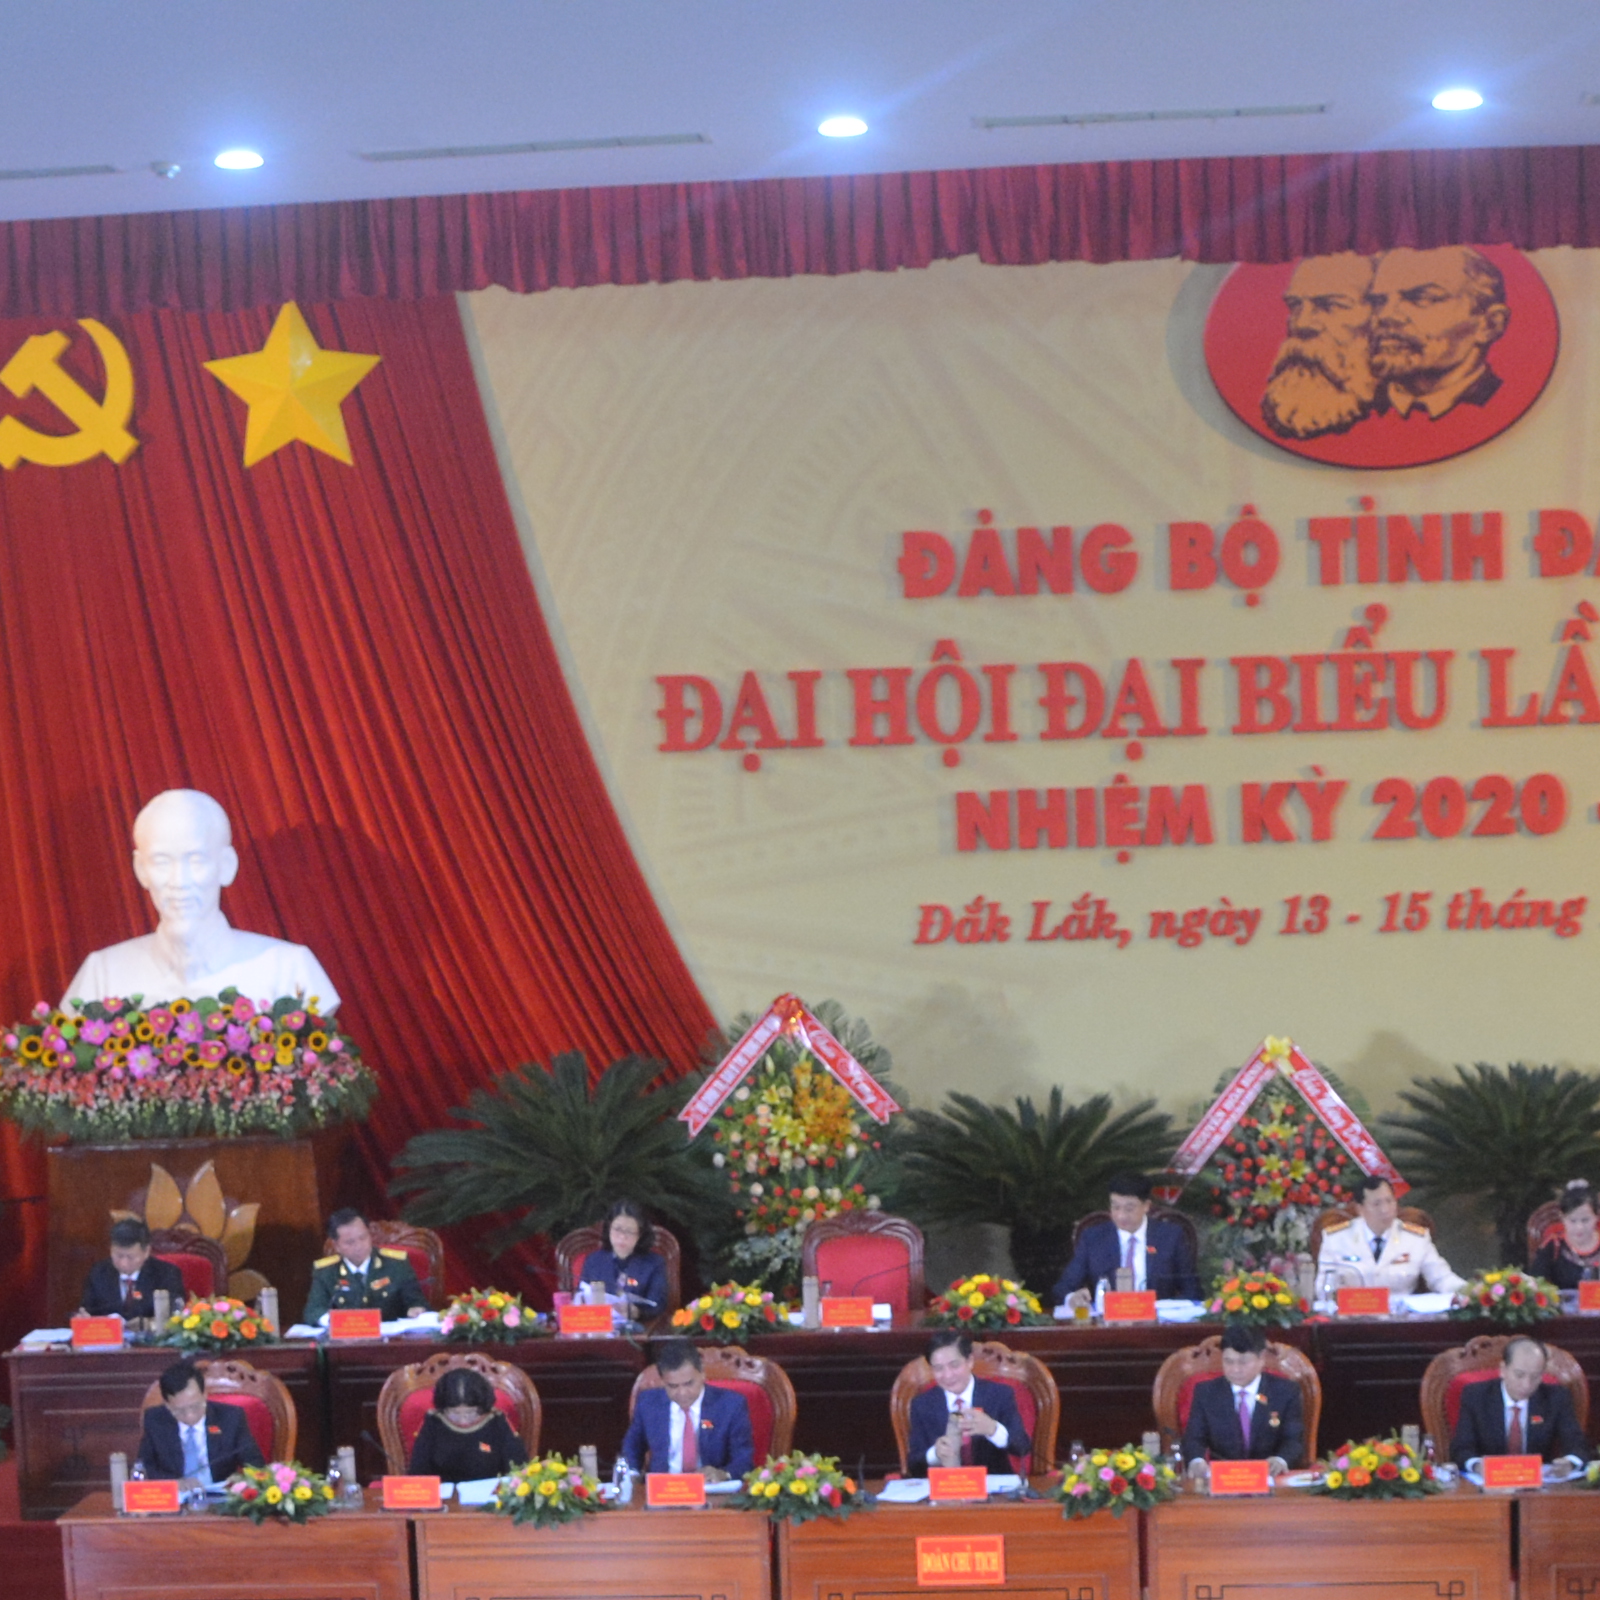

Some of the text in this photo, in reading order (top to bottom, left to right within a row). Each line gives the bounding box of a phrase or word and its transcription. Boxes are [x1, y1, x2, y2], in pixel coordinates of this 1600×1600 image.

[899, 511, 1138, 597] ĐẢNG
[1171, 504, 1280, 606] BỘ
[1310, 496, 1504, 584] TỈNH
[657, 671, 823, 771] ĐẠI
[848, 640, 1017, 767] HỘI
[1040, 659, 1207, 760] ĐẠI
[1232, 604, 1454, 733] BIỂU
[957, 774, 1213, 862] NHIỆM
[1242, 766, 1346, 842] KỲ
[1374, 773, 1567, 838] 2020
[917, 897, 1009, 943] Đắk
[1030, 894, 1130, 946] Lắk,
[1151, 899, 1260, 946] ngày
[1284, 896, 1329, 933] 13
[1383, 893, 1430, 931] 15
[1448, 888, 1586, 936] tháng
